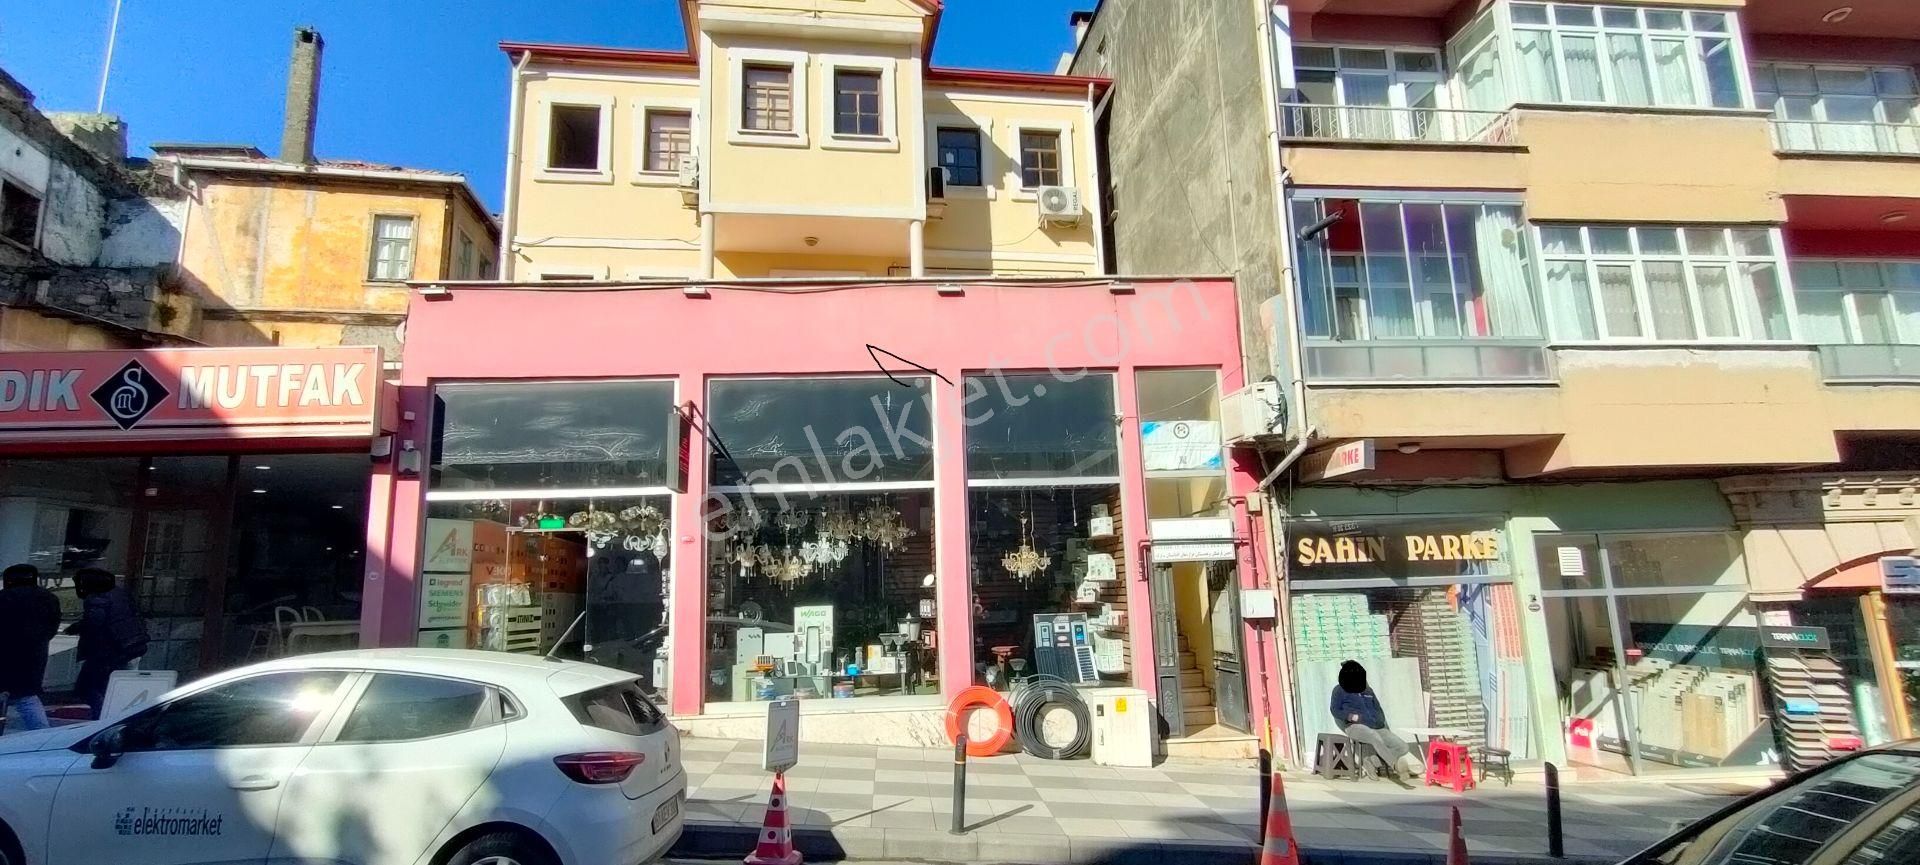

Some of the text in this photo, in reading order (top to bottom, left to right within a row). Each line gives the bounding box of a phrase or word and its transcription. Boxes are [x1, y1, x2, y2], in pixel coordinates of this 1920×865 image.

[177, 363, 366, 410] MUTFAK
[1405, 534, 1498, 561] PARKE
[800, 609, 827, 617] WAGO
[134, 807, 222, 836] elektromarket
